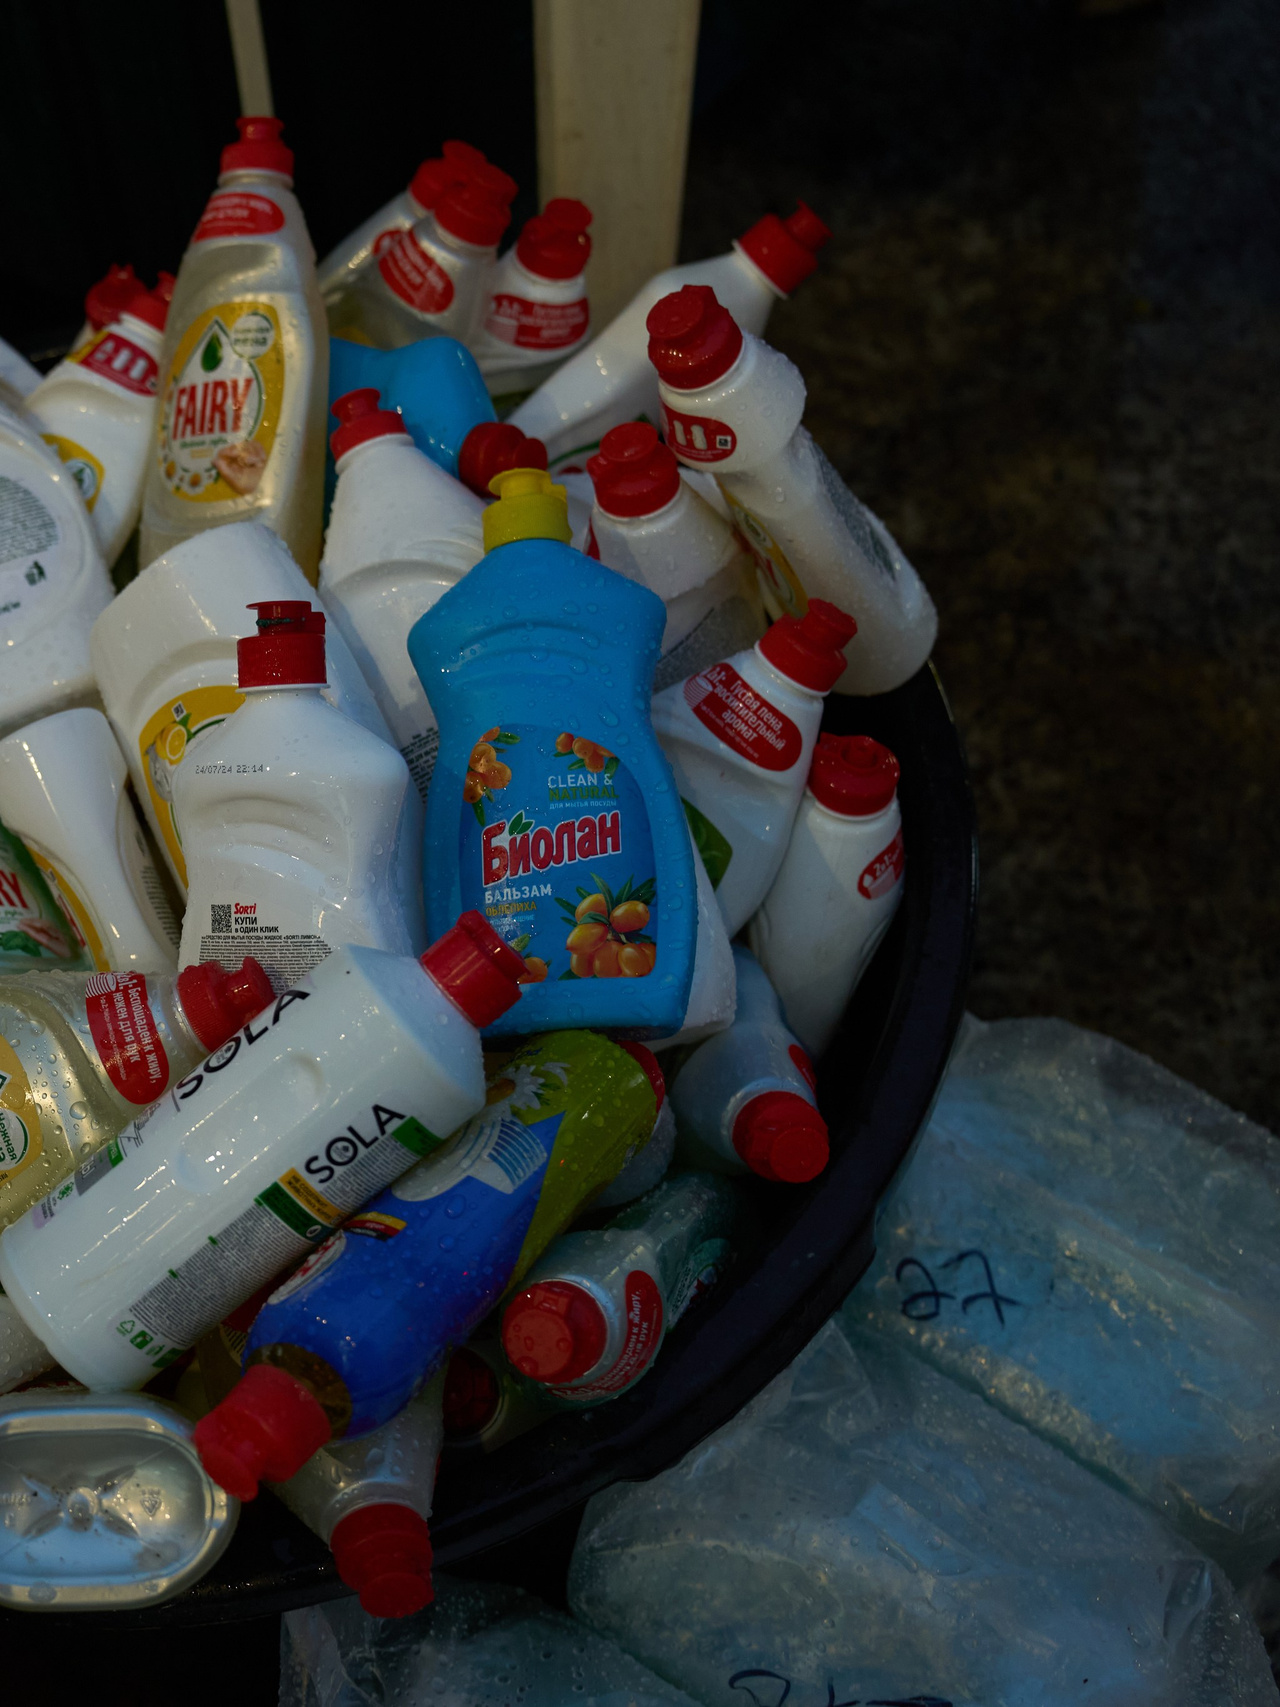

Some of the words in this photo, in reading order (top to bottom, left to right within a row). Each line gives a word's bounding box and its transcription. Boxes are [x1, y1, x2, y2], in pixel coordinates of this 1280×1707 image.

[172, 378, 254, 440] FAIRY
[713, 685, 787, 751] восхитительный
[730, 680, 760, 711] Густая
[757, 706, 783, 735] пена,
[722, 709, 758, 742] аромат
[236, 764, 264, 774] 22:14
[547, 773, 598, 789] CLEAN
[604, 773, 613, 785] &
[549, 786, 619, 801] NATURAL
[549, 802, 564, 810] ДЛЯ
[481, 811, 622, 888] Биолан
[485, 883, 552, 904] БАЛЬЗАМ
[486, 900, 537, 917] ОБЛЕПИХА
[234, 917, 257, 925] КУПИ
[240, 926, 258, 934] ОДИН
[112, 992, 128, 1019] нежен
[128, 986, 153, 1044] Беспощаден
[118, 1020, 135, 1042] для
[124, 1043, 141, 1063] рук
[143, 1043, 155, 1052] к
[175, 990, 310, 1100] SOLA
[145, 1052, 162, 1084] жиру,
[305, 1104, 406, 1183] SOLA
